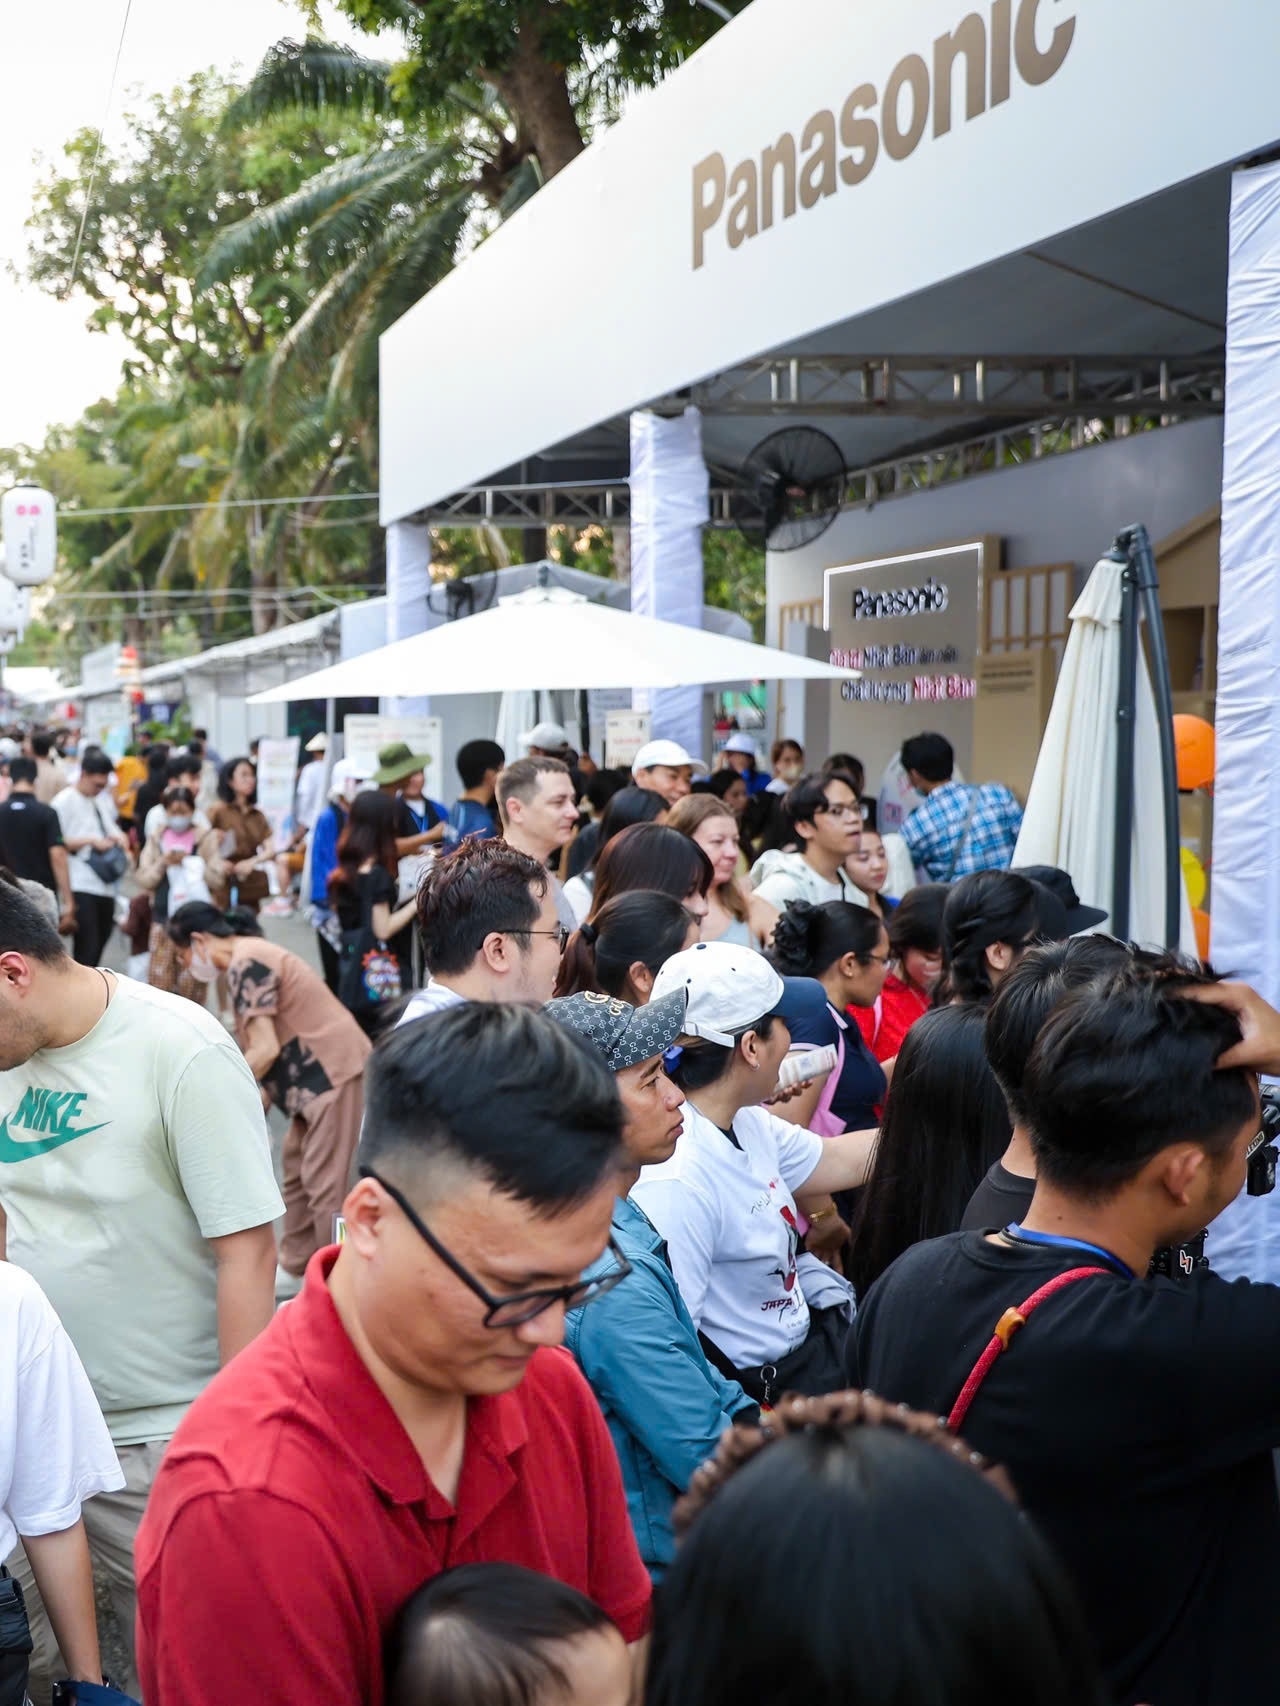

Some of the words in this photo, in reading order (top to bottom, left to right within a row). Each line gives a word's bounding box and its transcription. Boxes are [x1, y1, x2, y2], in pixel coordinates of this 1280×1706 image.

[692, 0, 1077, 271] Panasonic
[853, 577, 949, 621] Panasonic
[9, 1085, 87, 1134] NIKE
